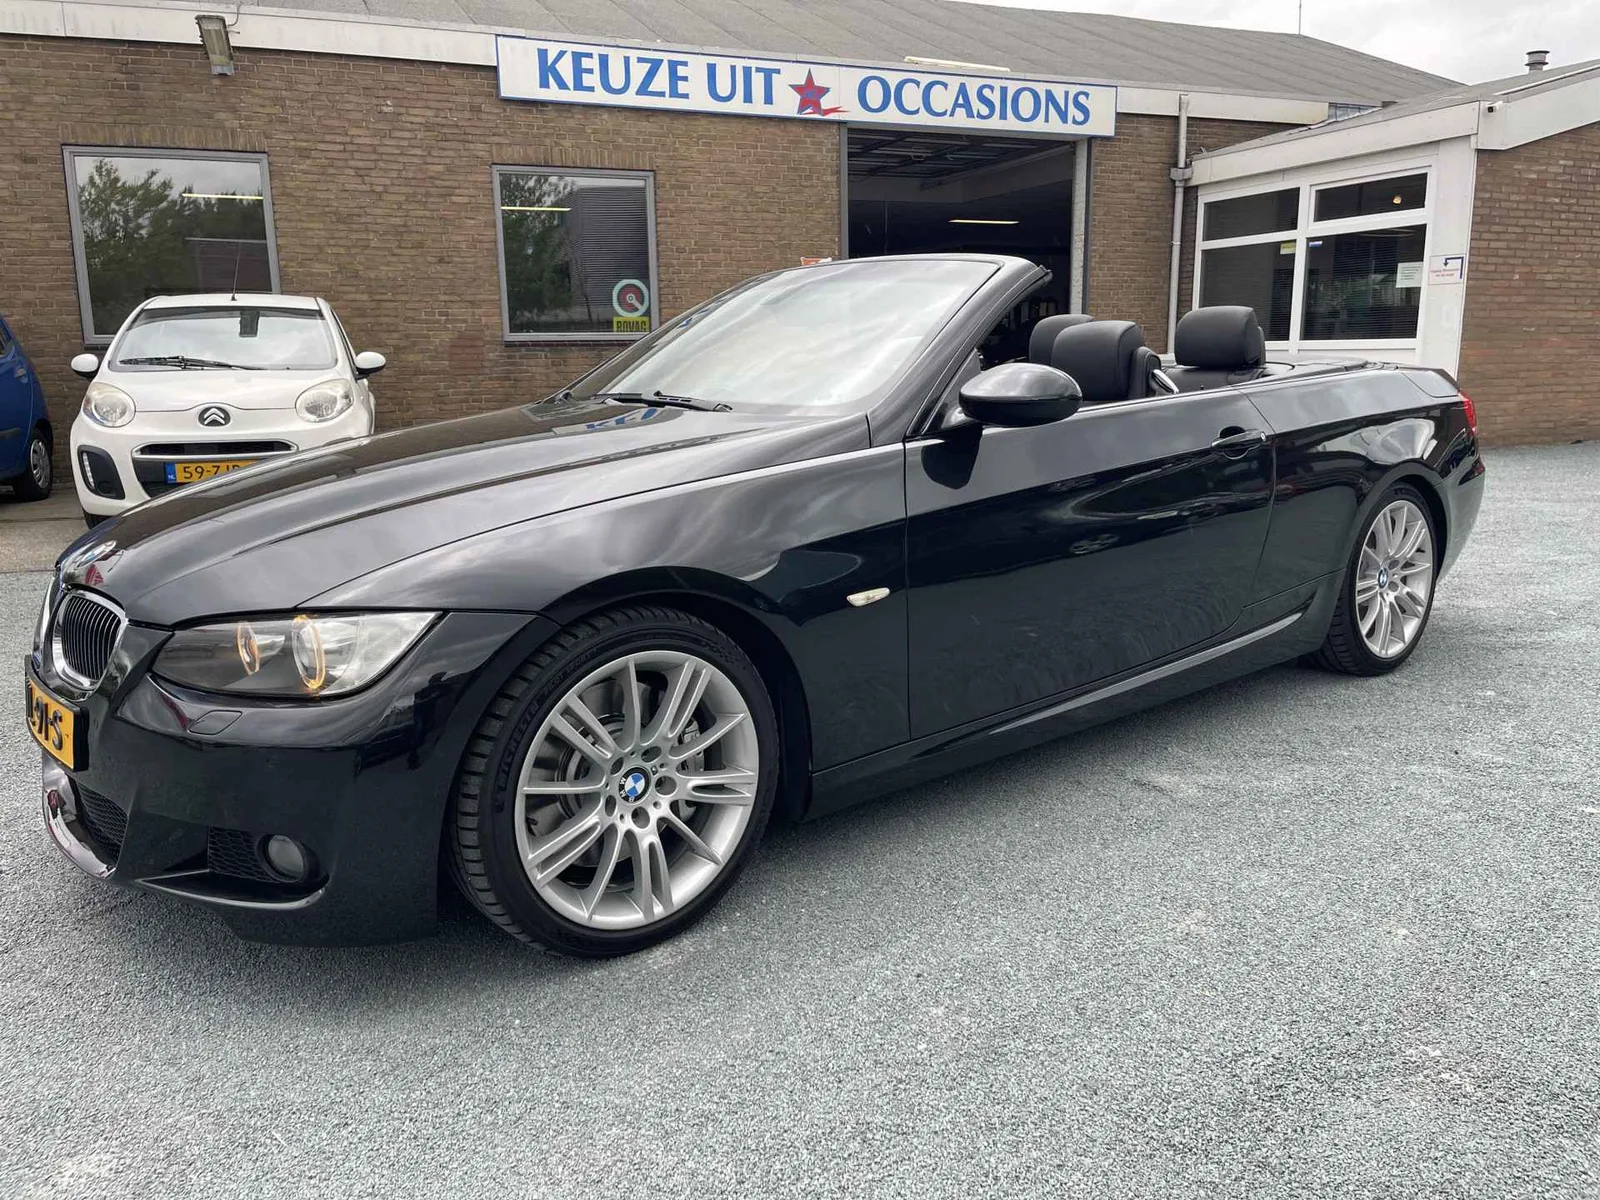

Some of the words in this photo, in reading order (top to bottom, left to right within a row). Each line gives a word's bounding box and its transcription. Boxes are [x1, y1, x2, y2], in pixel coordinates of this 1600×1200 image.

[536, 47, 690, 100] KEUZE
[706, 62, 781, 105] UIT
[856, 74, 1091, 126] OCCASIONS
[616, 320, 648, 333] BOVAG
